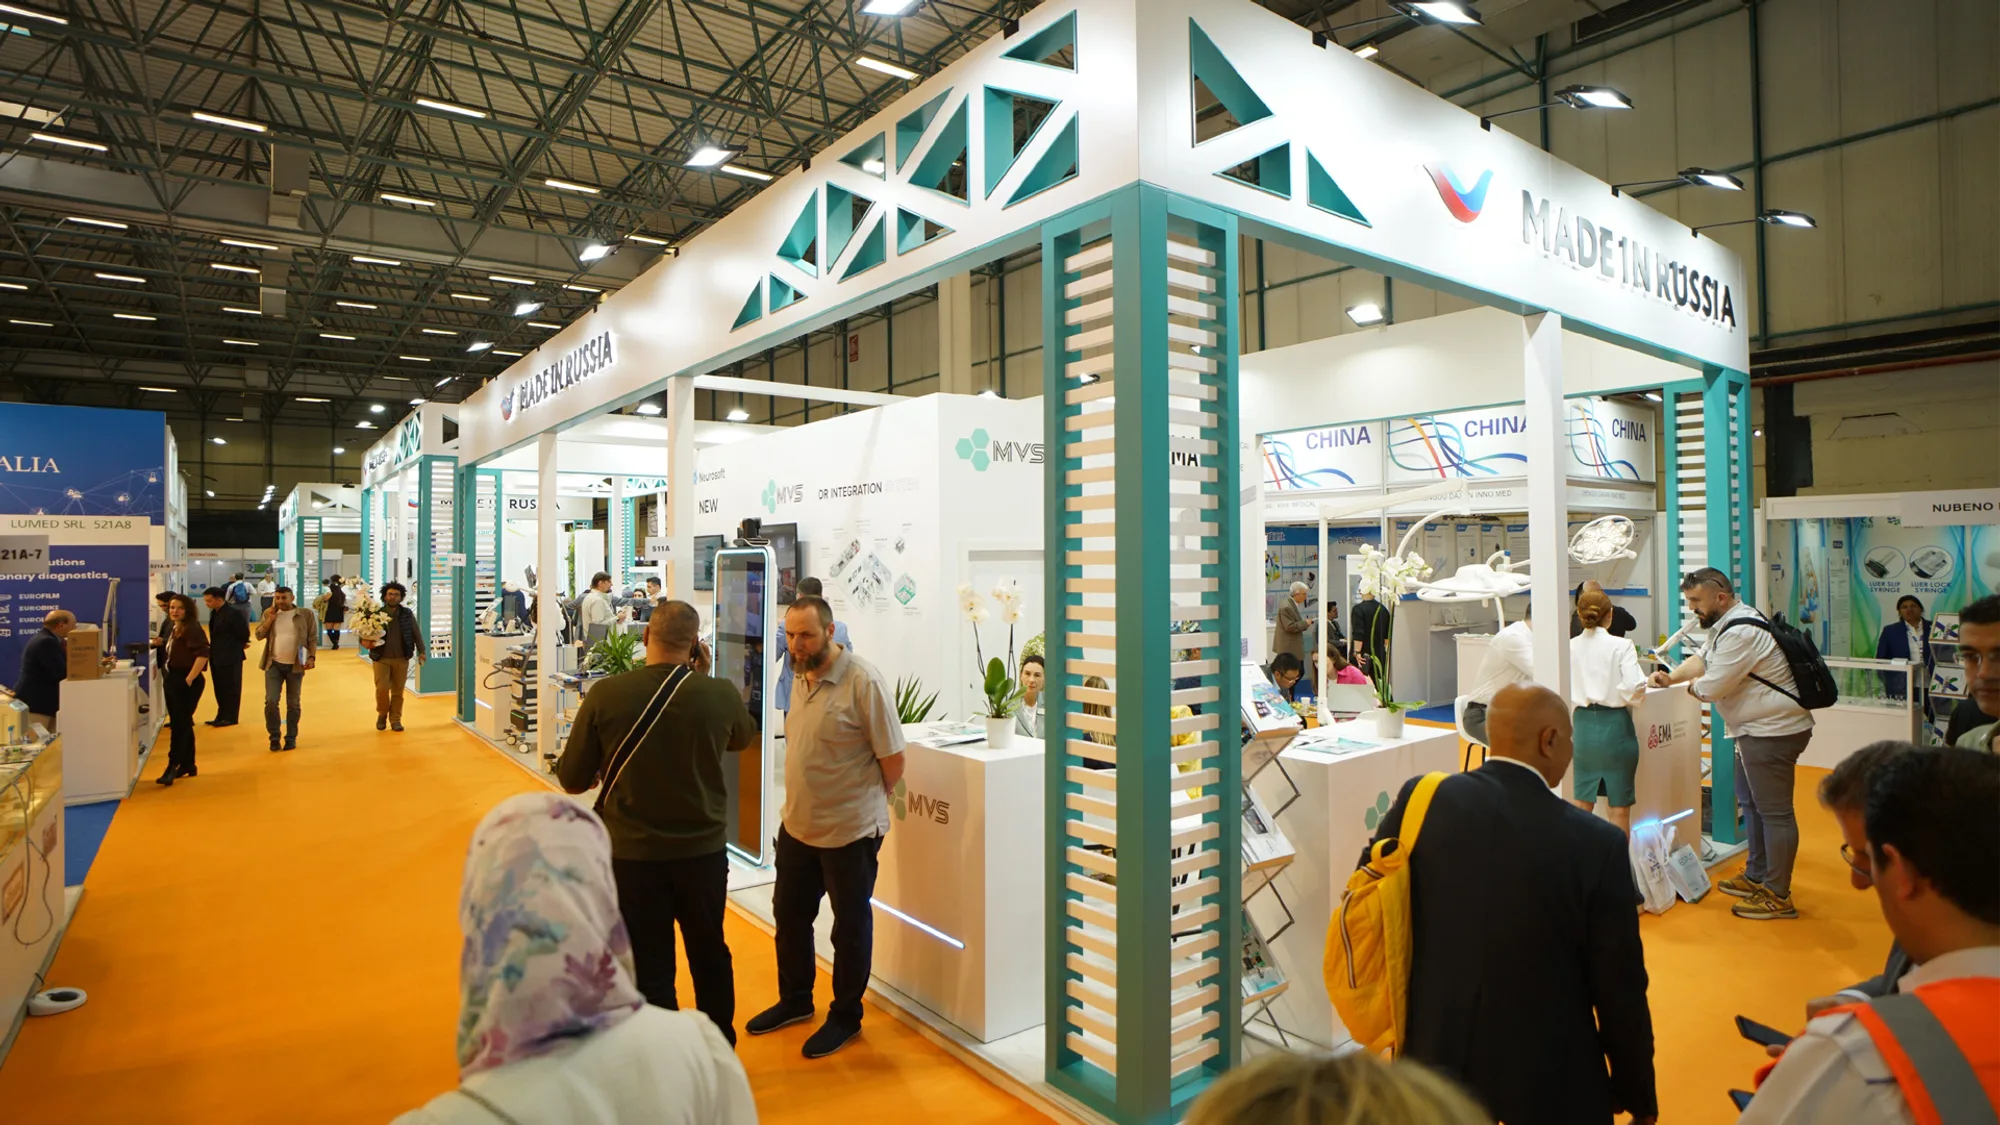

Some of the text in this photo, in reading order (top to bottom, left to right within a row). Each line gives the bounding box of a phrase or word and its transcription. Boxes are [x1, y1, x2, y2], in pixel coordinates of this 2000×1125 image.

[1522, 189, 1737, 328] MADE IN RUSSIA
[520, 331, 613, 411] MADE IN RUSSIA
[1306, 426, 1371, 450] CHINA
[1611, 418, 1647, 442] CHINA
[992, 440, 1045, 464] MVS
[699, 468, 726, 483] Neurosoft
[776, 484, 804, 504] MVS
[831, 482, 883, 498] INTEGRATION
[699, 498, 719, 514] NEW
[1932, 502, 1994, 513] NUBENO
[11, 519, 132, 530] LUMED SRL 521A8
[48, 558, 86, 566] utions
[19, 592, 60, 600] EUROFILM
[1658, 723, 1672, 743] EMA
[908, 790, 950, 825] MVS
